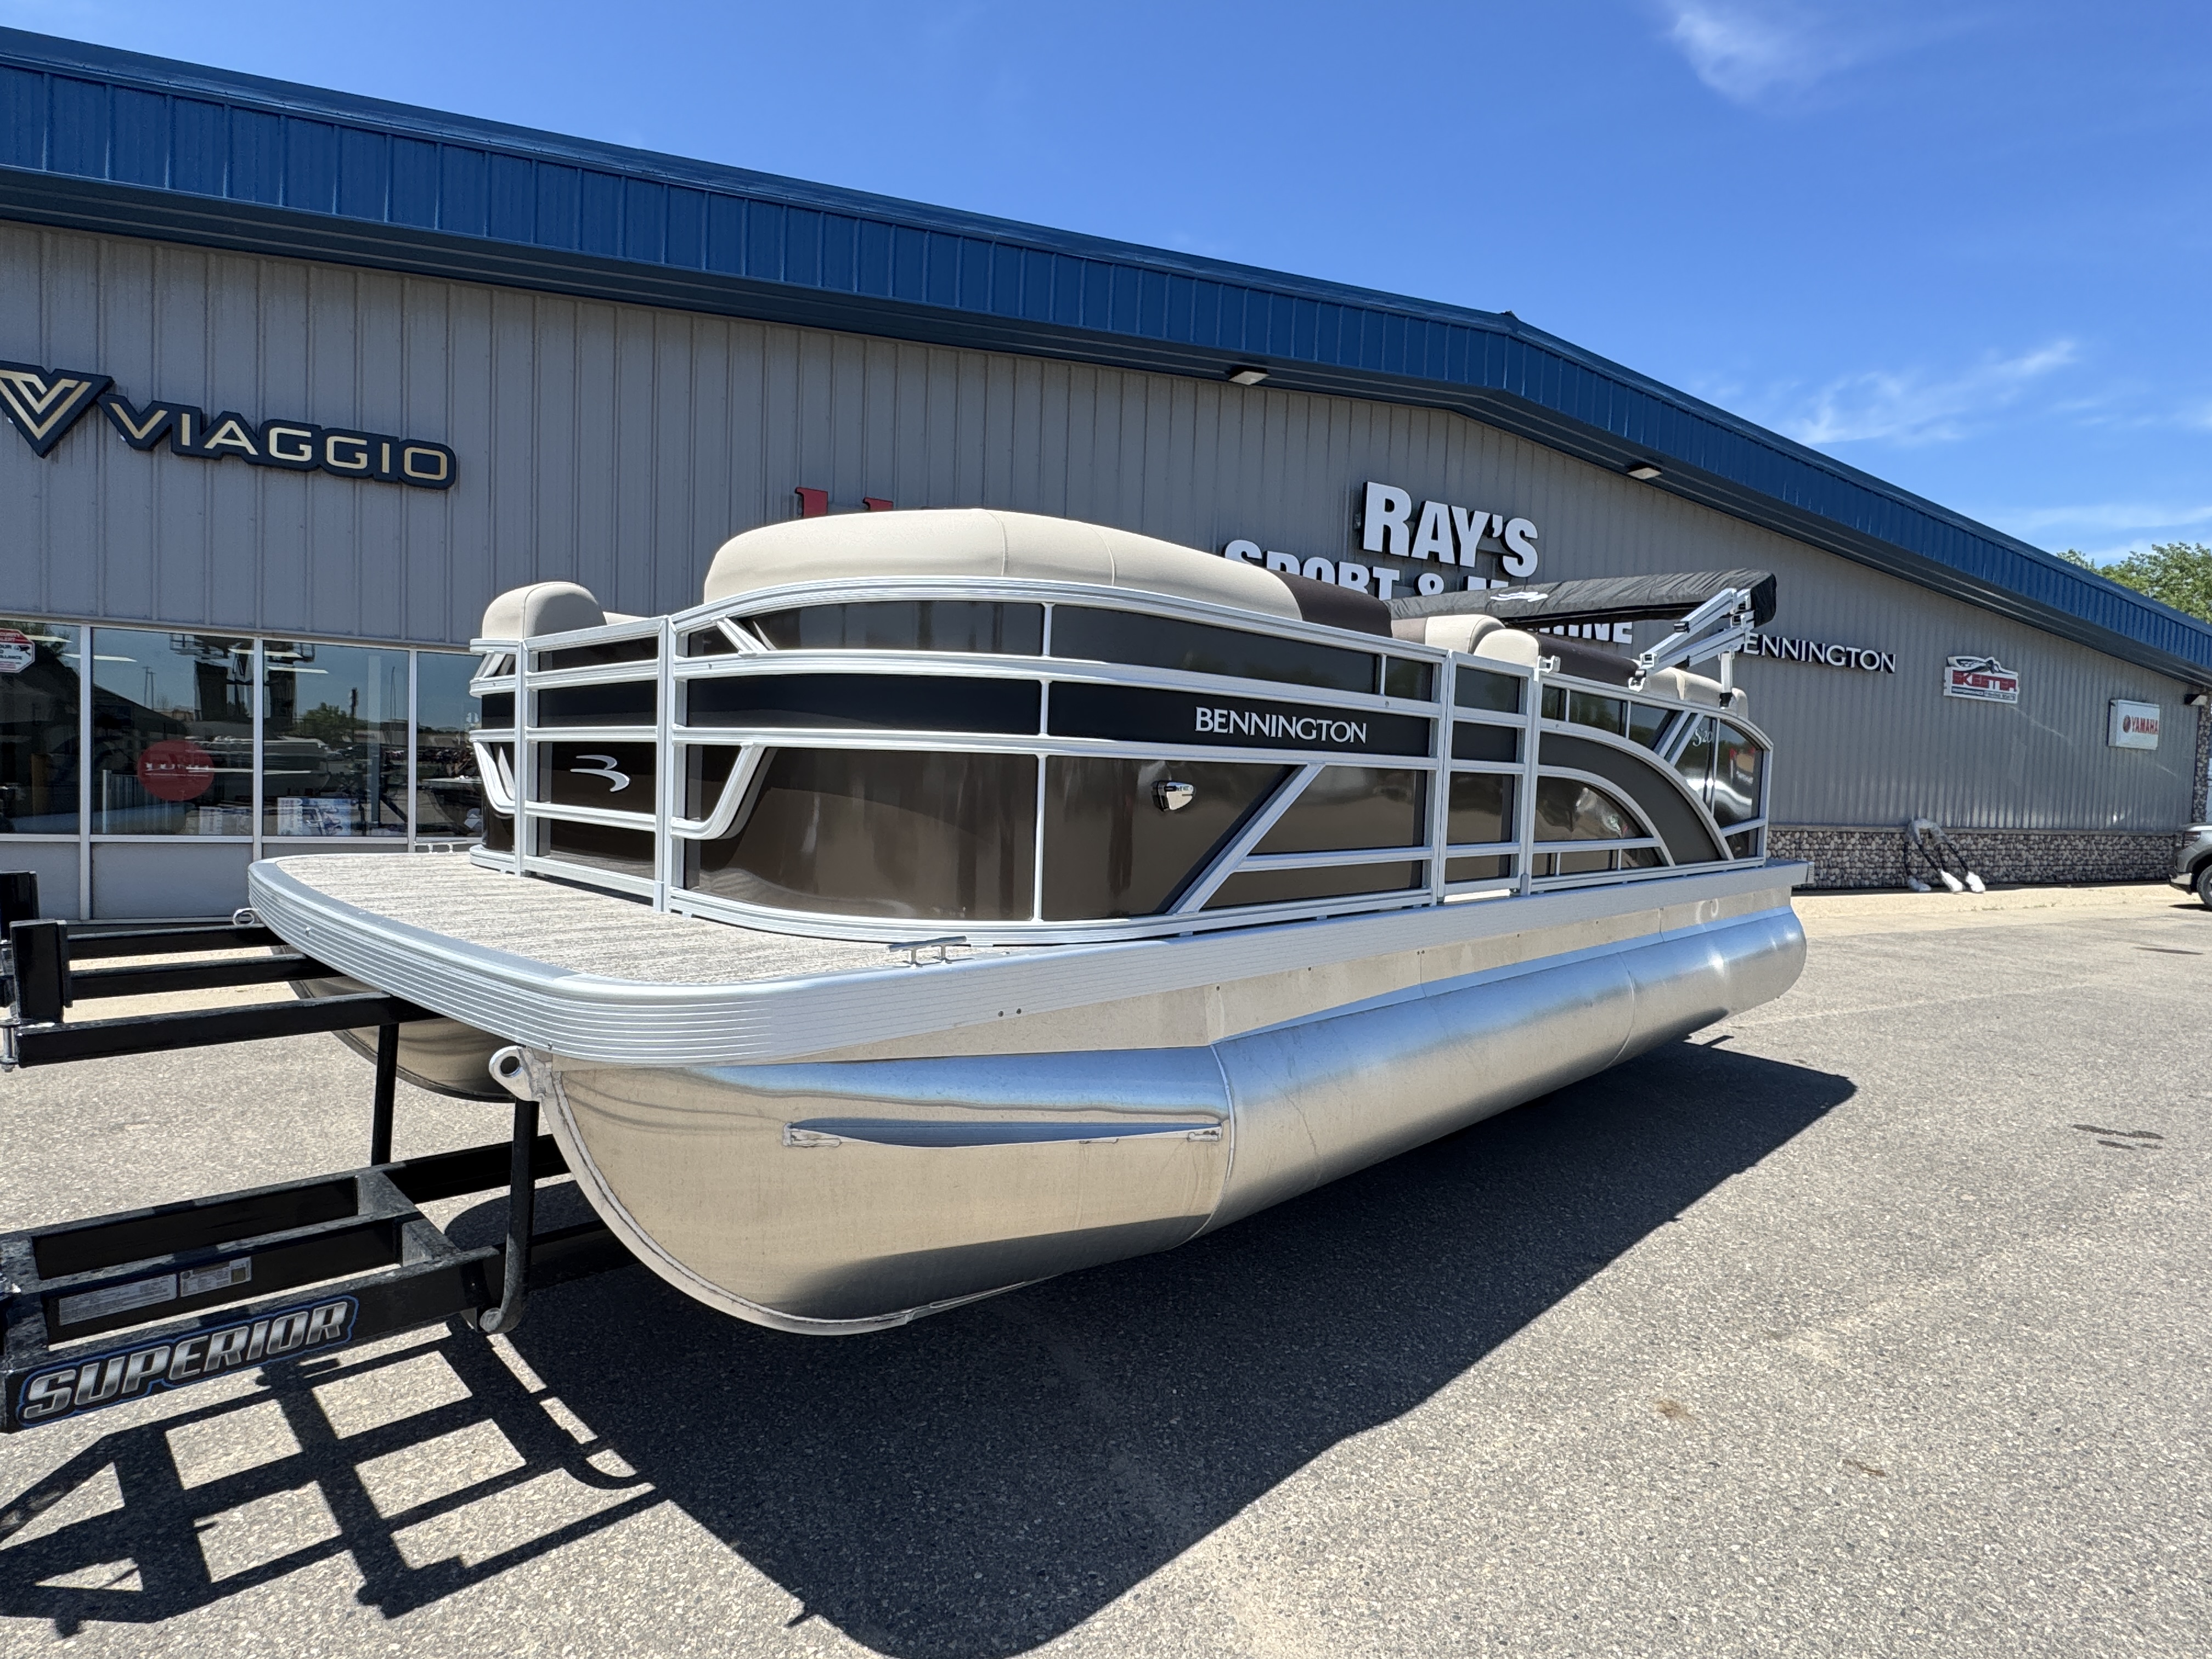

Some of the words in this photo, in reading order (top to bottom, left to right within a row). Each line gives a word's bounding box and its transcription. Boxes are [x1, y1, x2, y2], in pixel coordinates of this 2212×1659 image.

[109, 402, 448, 481] VIAGGIO
[1363, 482, 1538, 578] RAY'S
[1734, 632, 1896, 673] ENNINGTON
[1195, 706, 1367, 744] BENNINGTON
[2131, 715, 2159, 735] YAMAHA
[23, 1301, 348, 1419] SUPERIOR
